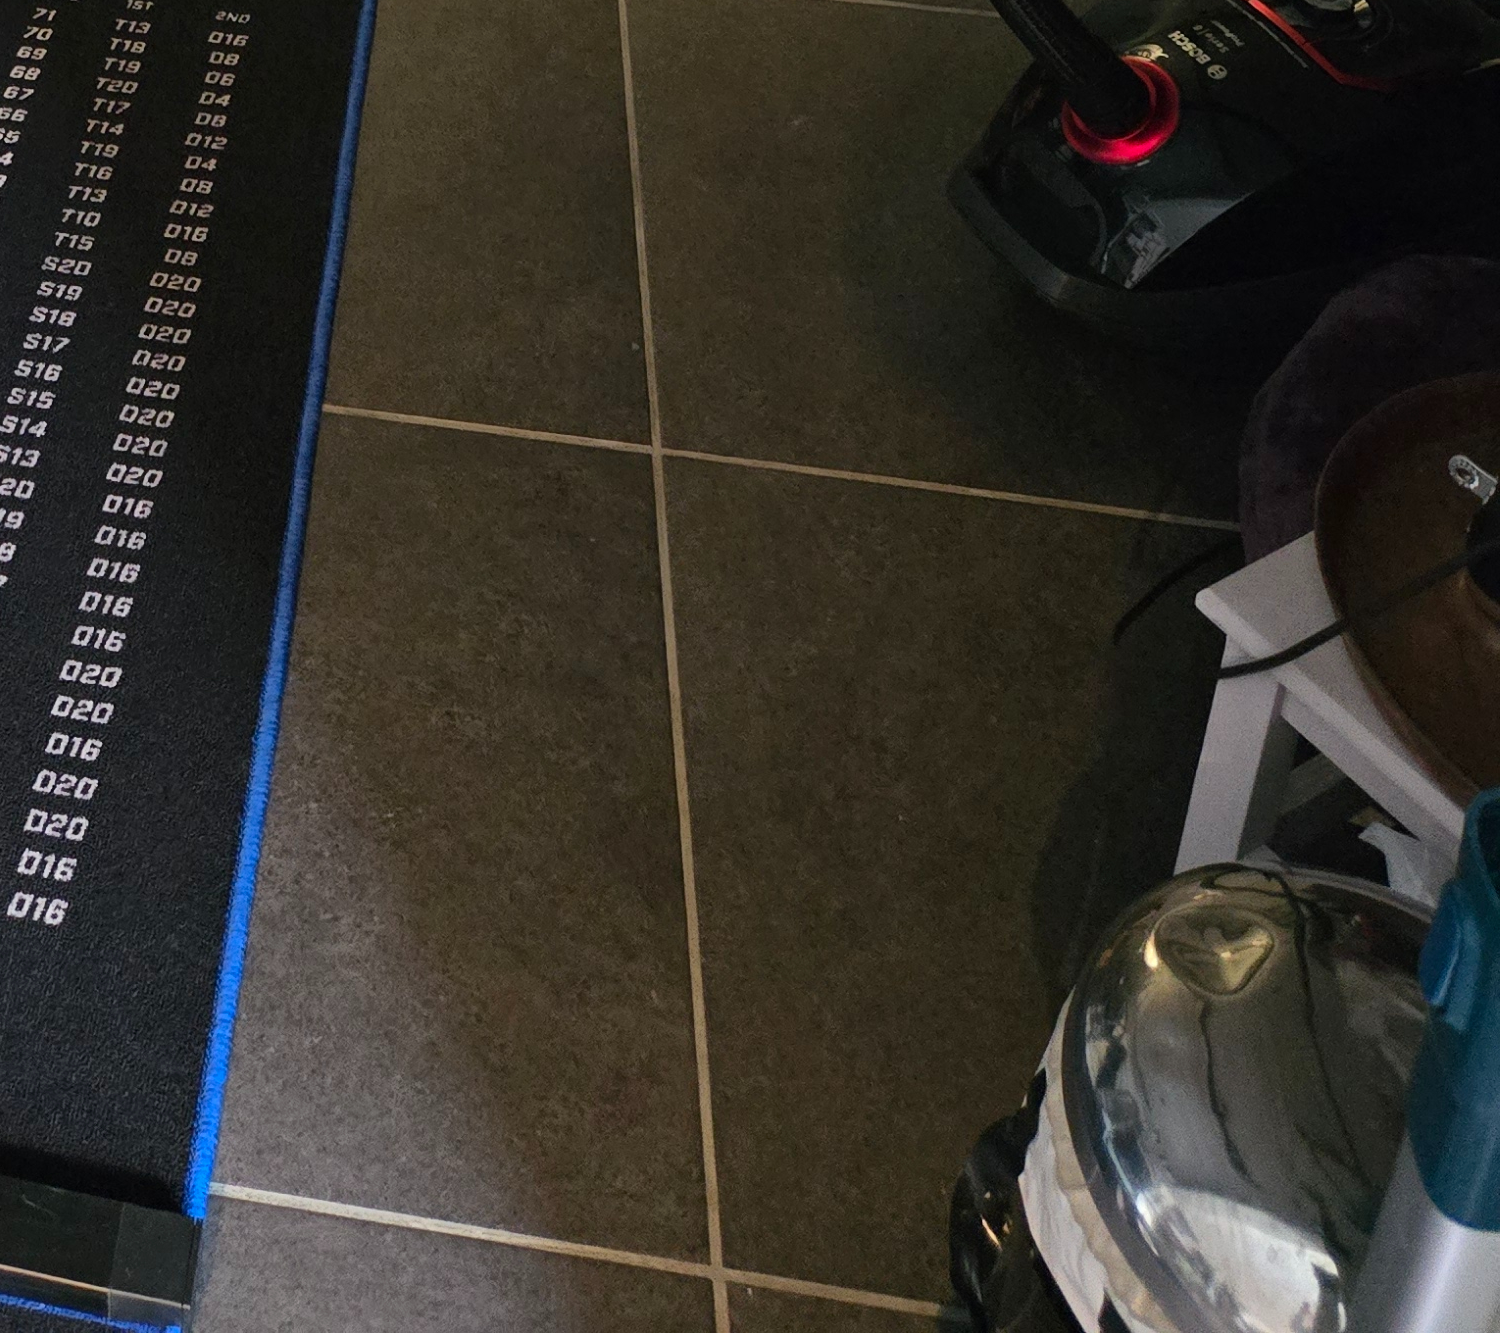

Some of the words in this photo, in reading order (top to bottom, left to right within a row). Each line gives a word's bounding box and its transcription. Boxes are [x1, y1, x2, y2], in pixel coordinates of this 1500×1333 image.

[32, 7, 57, 21] 71
[116, 18, 151, 34] T13
[208, 31, 249, 47] D16
[126, 0, 154, 10] 1ST
[215, 11, 251, 24] 2ND
[1167, 30, 1212, 65] BOSCH
[9, 65, 41, 81] 68
[97, 77, 138, 94] T20
[198, 91, 231, 107] D4
[75, 162, 113, 180] T16
[179, 178, 214, 194] D8
[41, 256, 92, 276] S20
[149, 272, 201, 292] D20
[23, 333, 70, 353] S17
[132, 349, 186, 372] D20
[0, 415, 47, 437] S14
[113, 433, 168, 457] D20
[94, 525, 146, 550] D16
[71, 625, 126, 652] D16
[45, 732, 102, 761] D16
[17, 849, 77, 881] D16
